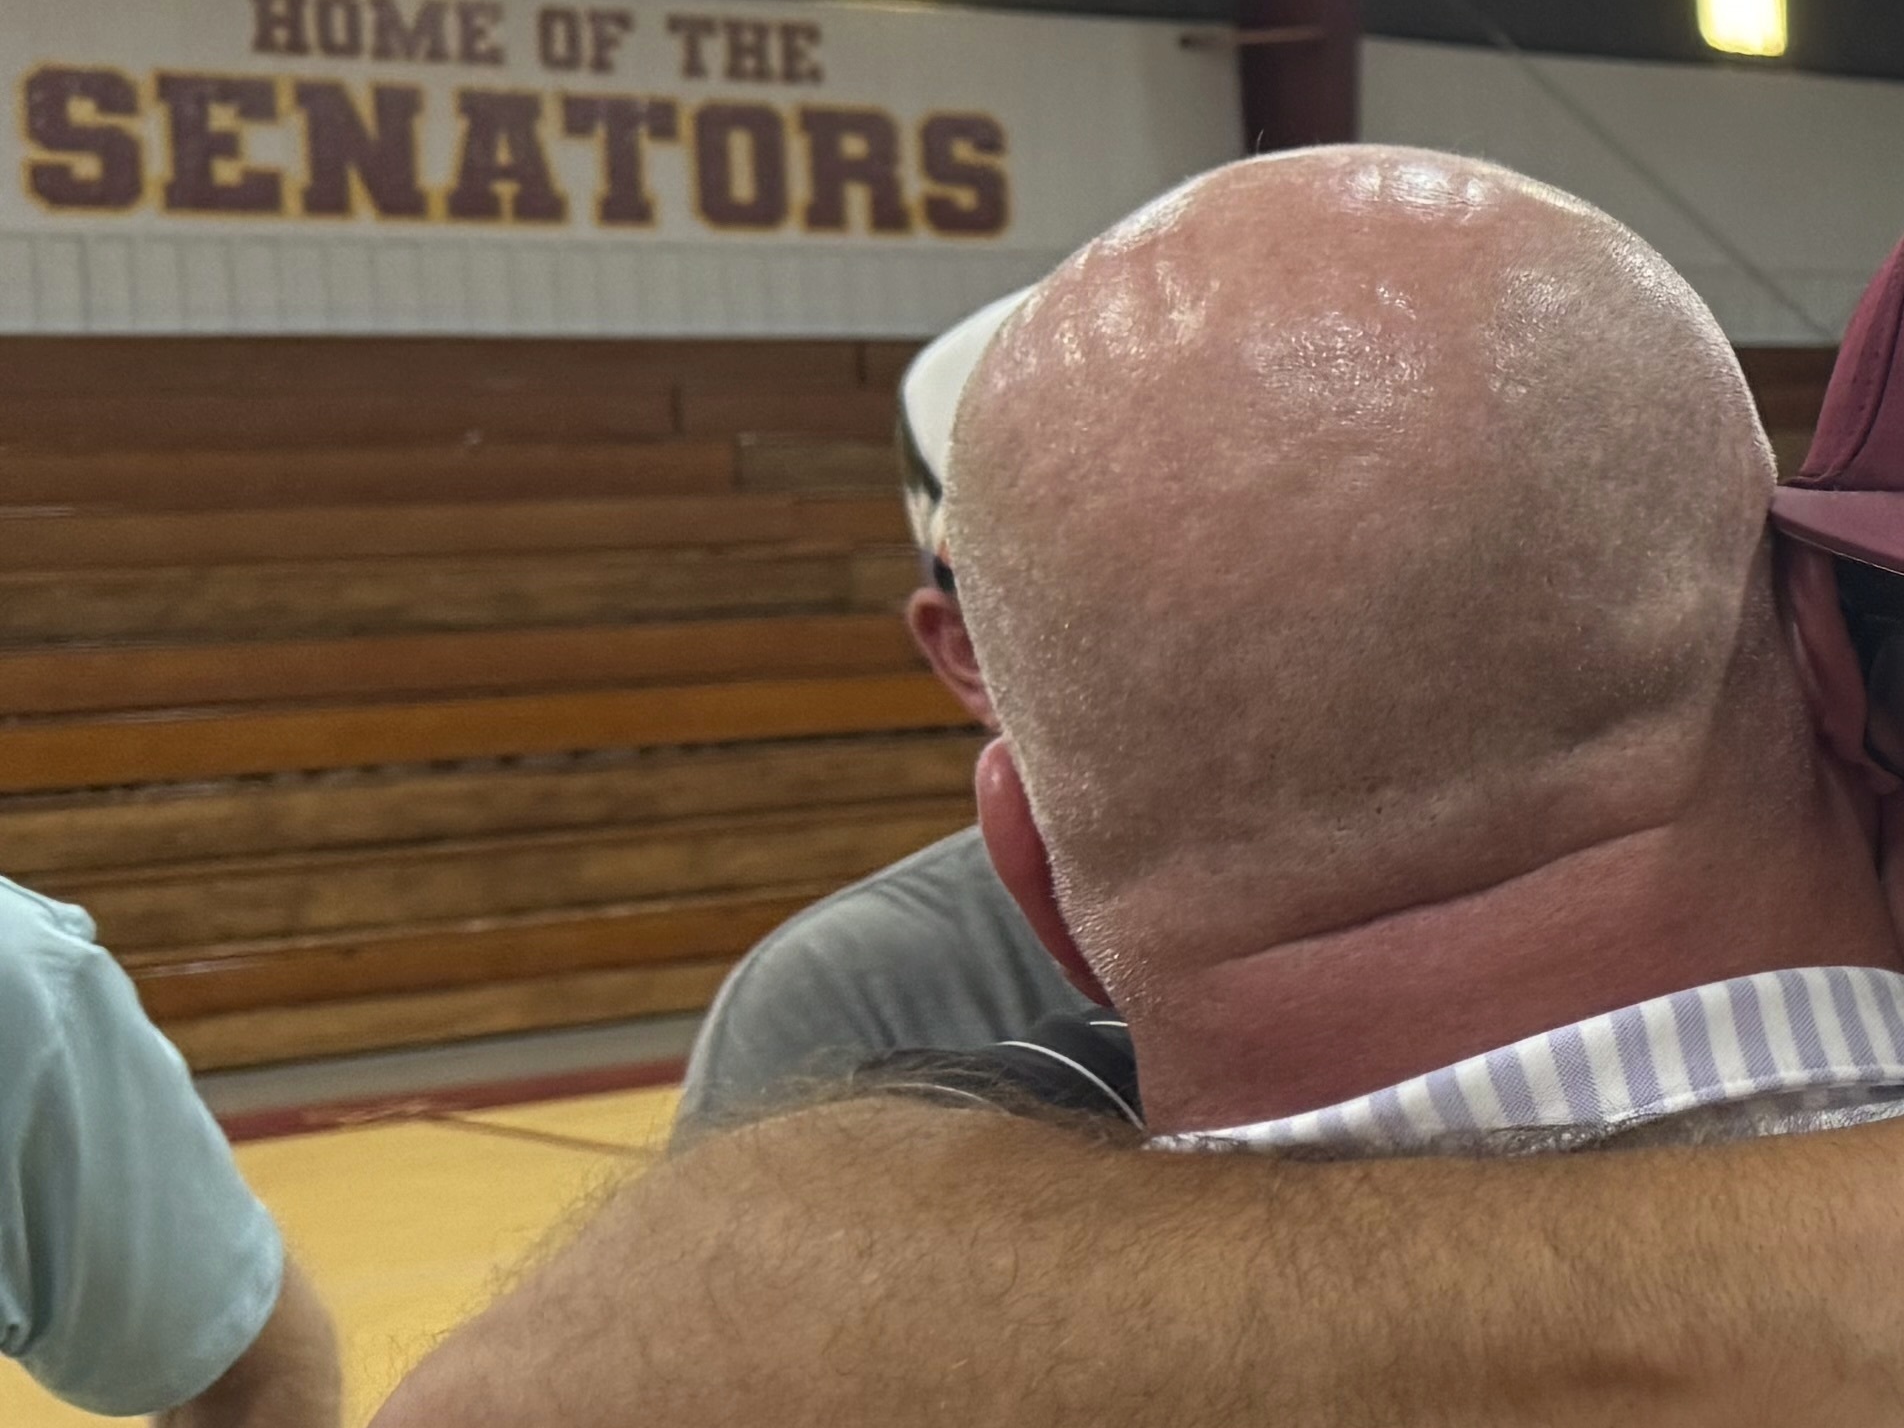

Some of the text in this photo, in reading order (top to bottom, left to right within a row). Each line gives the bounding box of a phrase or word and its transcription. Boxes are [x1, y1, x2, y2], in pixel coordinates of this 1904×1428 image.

[537, 6, 634, 73] OF
[666, 13, 825, 86] THE
[16, 60, 1012, 239] SENATORS
